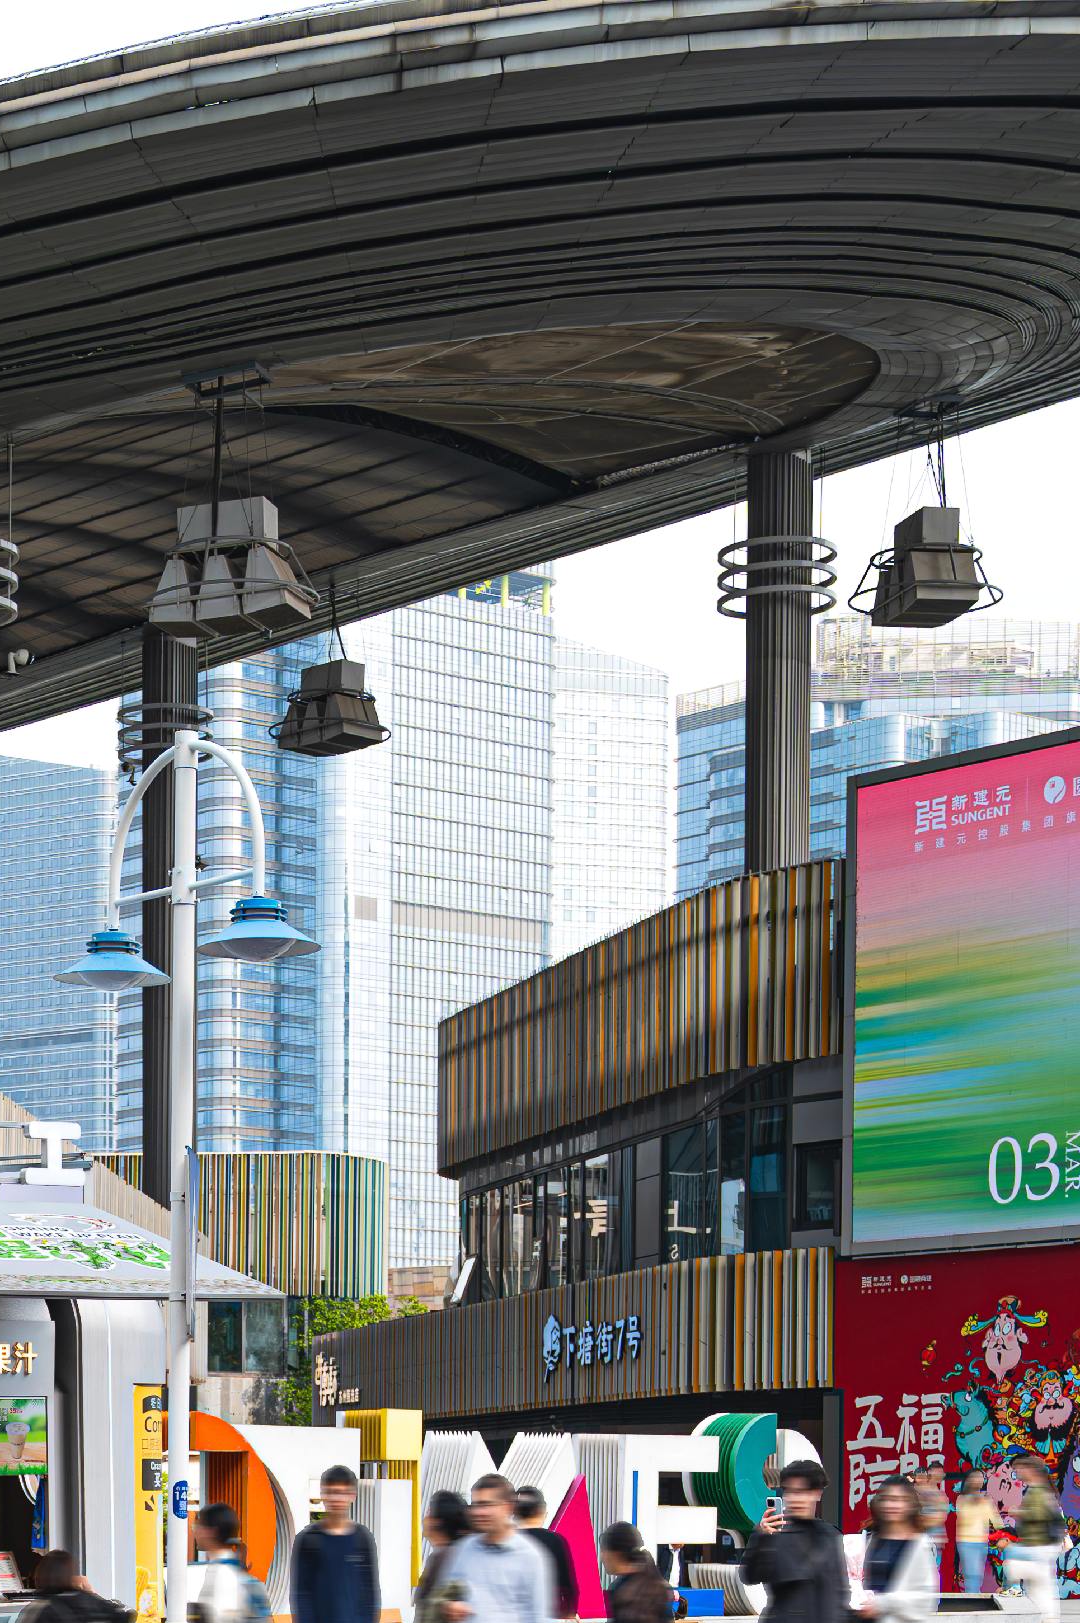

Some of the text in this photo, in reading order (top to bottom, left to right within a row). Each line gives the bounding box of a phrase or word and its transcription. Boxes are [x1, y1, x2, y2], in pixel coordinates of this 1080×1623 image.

[951, 785, 1012, 811] 新建元
[951, 804, 1012, 826] SUNGENT
[988, 1132, 1060, 1204] 03
[2, 1224, 70, 1233] SPRING
[16, 1232, 65, 1240] WAKE
[100, 1233, 142, 1242] PLAN
[563, 1315, 641, 1368] 下塘街7号
[846, 1393, 949, 1453] 五福
